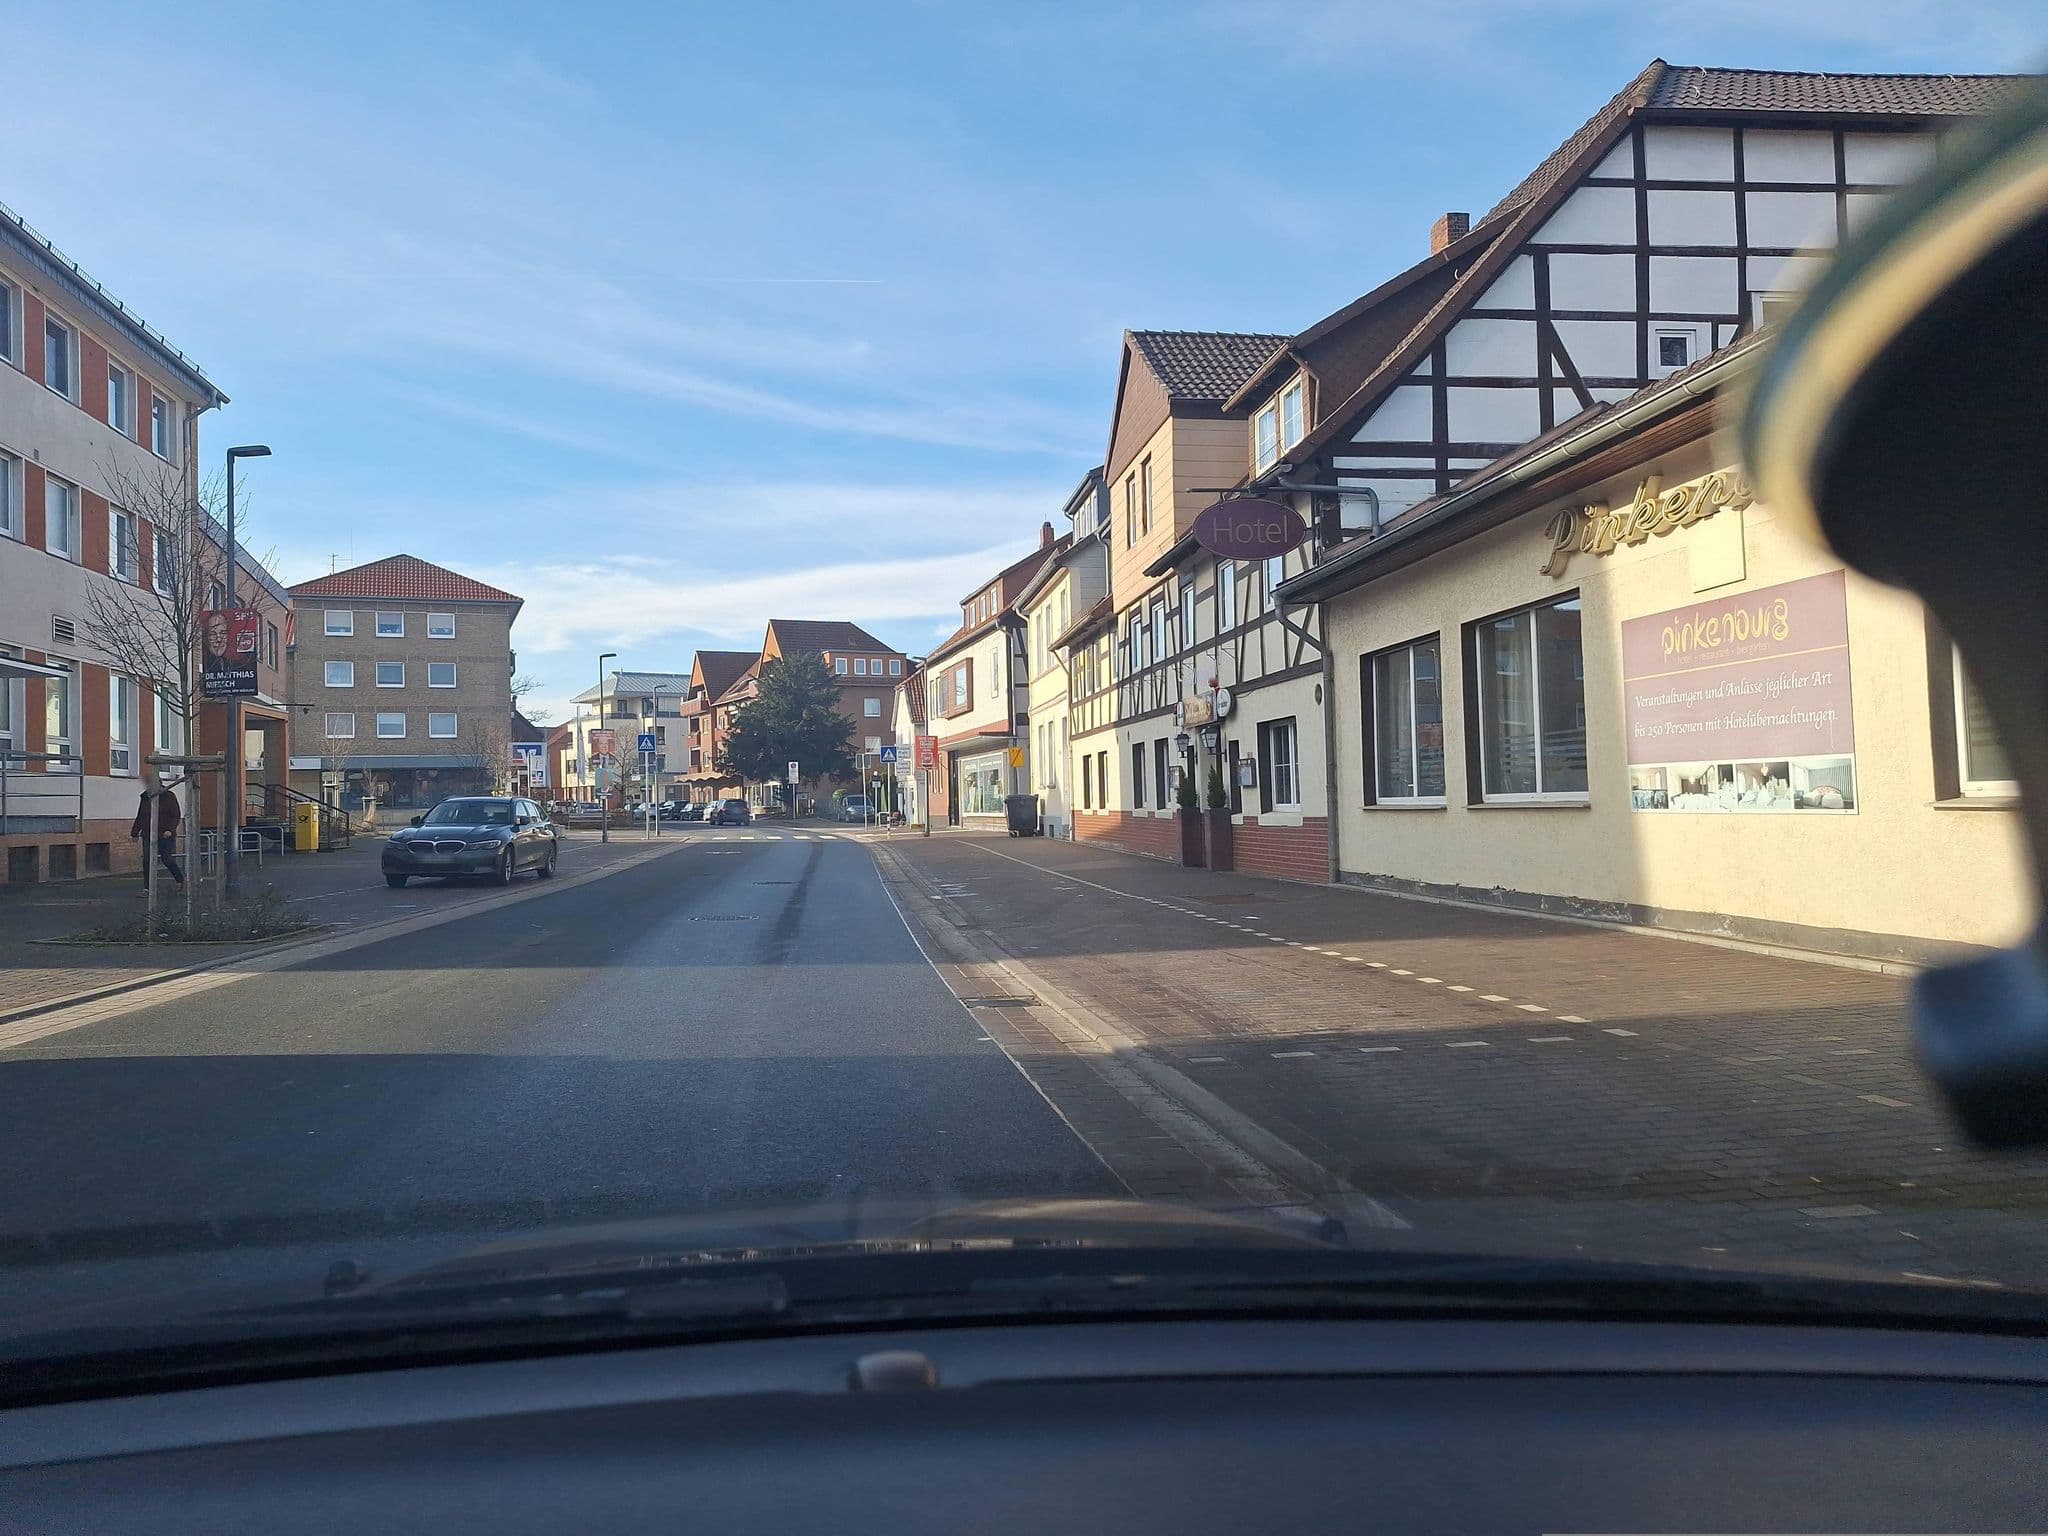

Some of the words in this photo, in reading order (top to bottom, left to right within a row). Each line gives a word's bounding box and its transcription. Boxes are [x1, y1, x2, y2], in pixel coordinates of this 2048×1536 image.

[1213, 515, 1288, 543] Hotel
[1661, 598, 1789, 664] pinkenburg
[1635, 688, 1703, 709] Veranstaltungen
[1705, 680, 1726, 700] und
[1726, 678, 1762, 697] Anlässe
[1763, 670, 1809, 700] jeglicher
[1811, 671, 1833, 687] Art
[1634, 721, 1646, 738] bis
[1648, 725, 1663, 738] 250
[1665, 721, 1703, 735] Personen
[1705, 716, 1721, 732] mit
[1724, 705, 1839, 730] Hotelübernachtungen.
